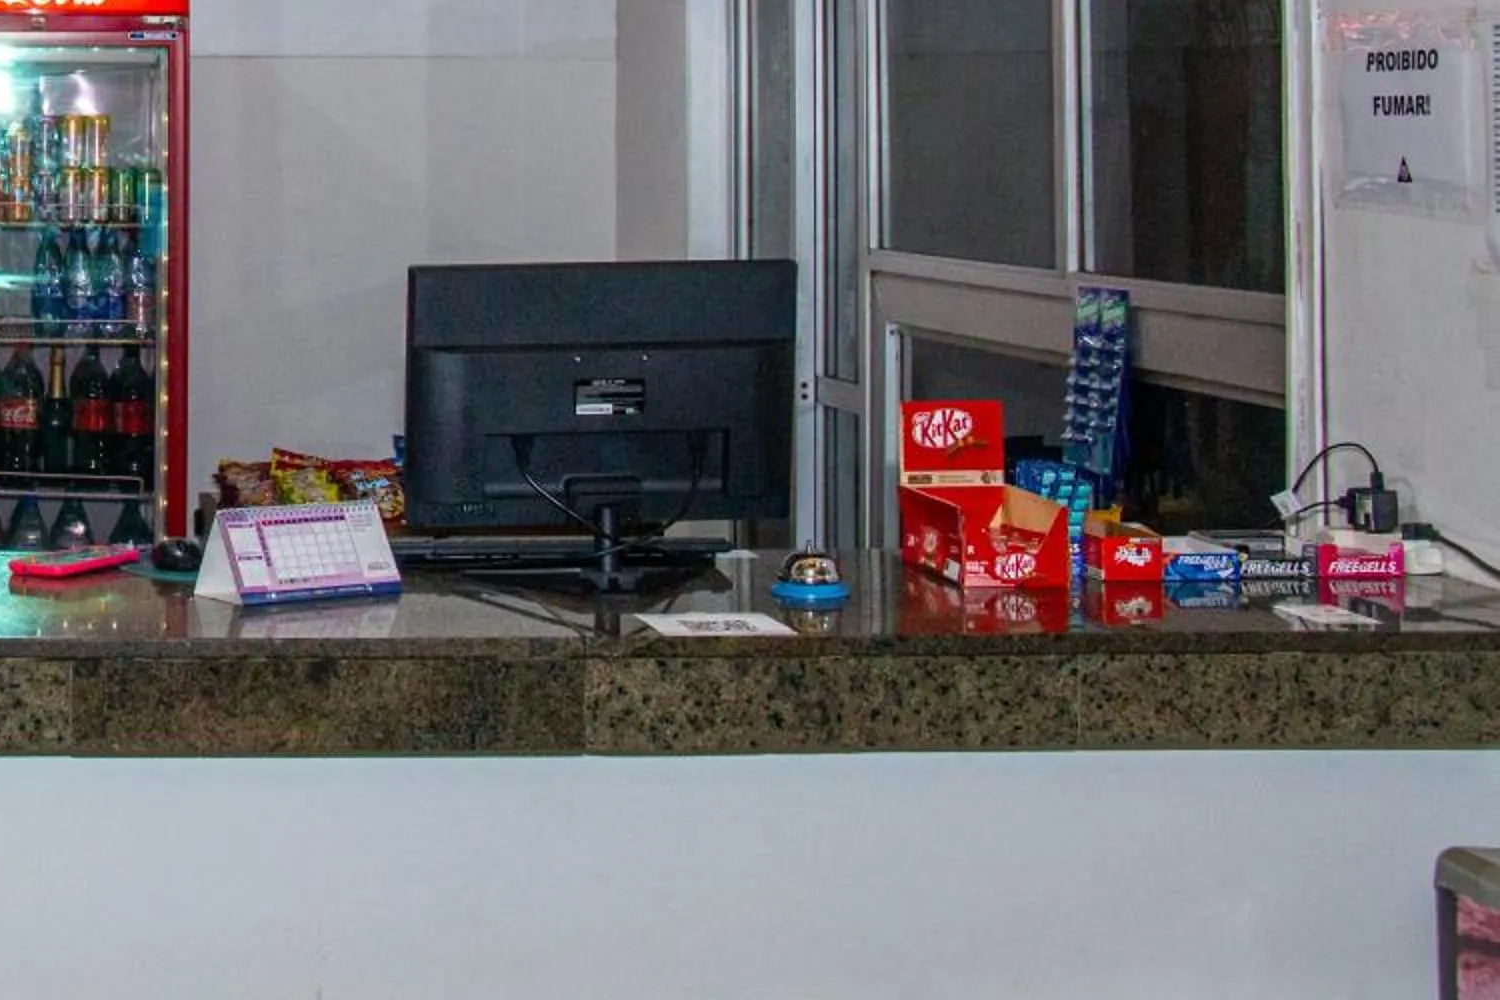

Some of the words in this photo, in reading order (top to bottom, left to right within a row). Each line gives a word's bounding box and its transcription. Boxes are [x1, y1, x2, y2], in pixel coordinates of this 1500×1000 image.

[1365, 48, 1439, 72] PROIBIDO
[1373, 94, 1431, 116] FUMAR!
[920, 409, 968, 447] KitKat
[1328, 560, 1398, 574] FREEGELLS
